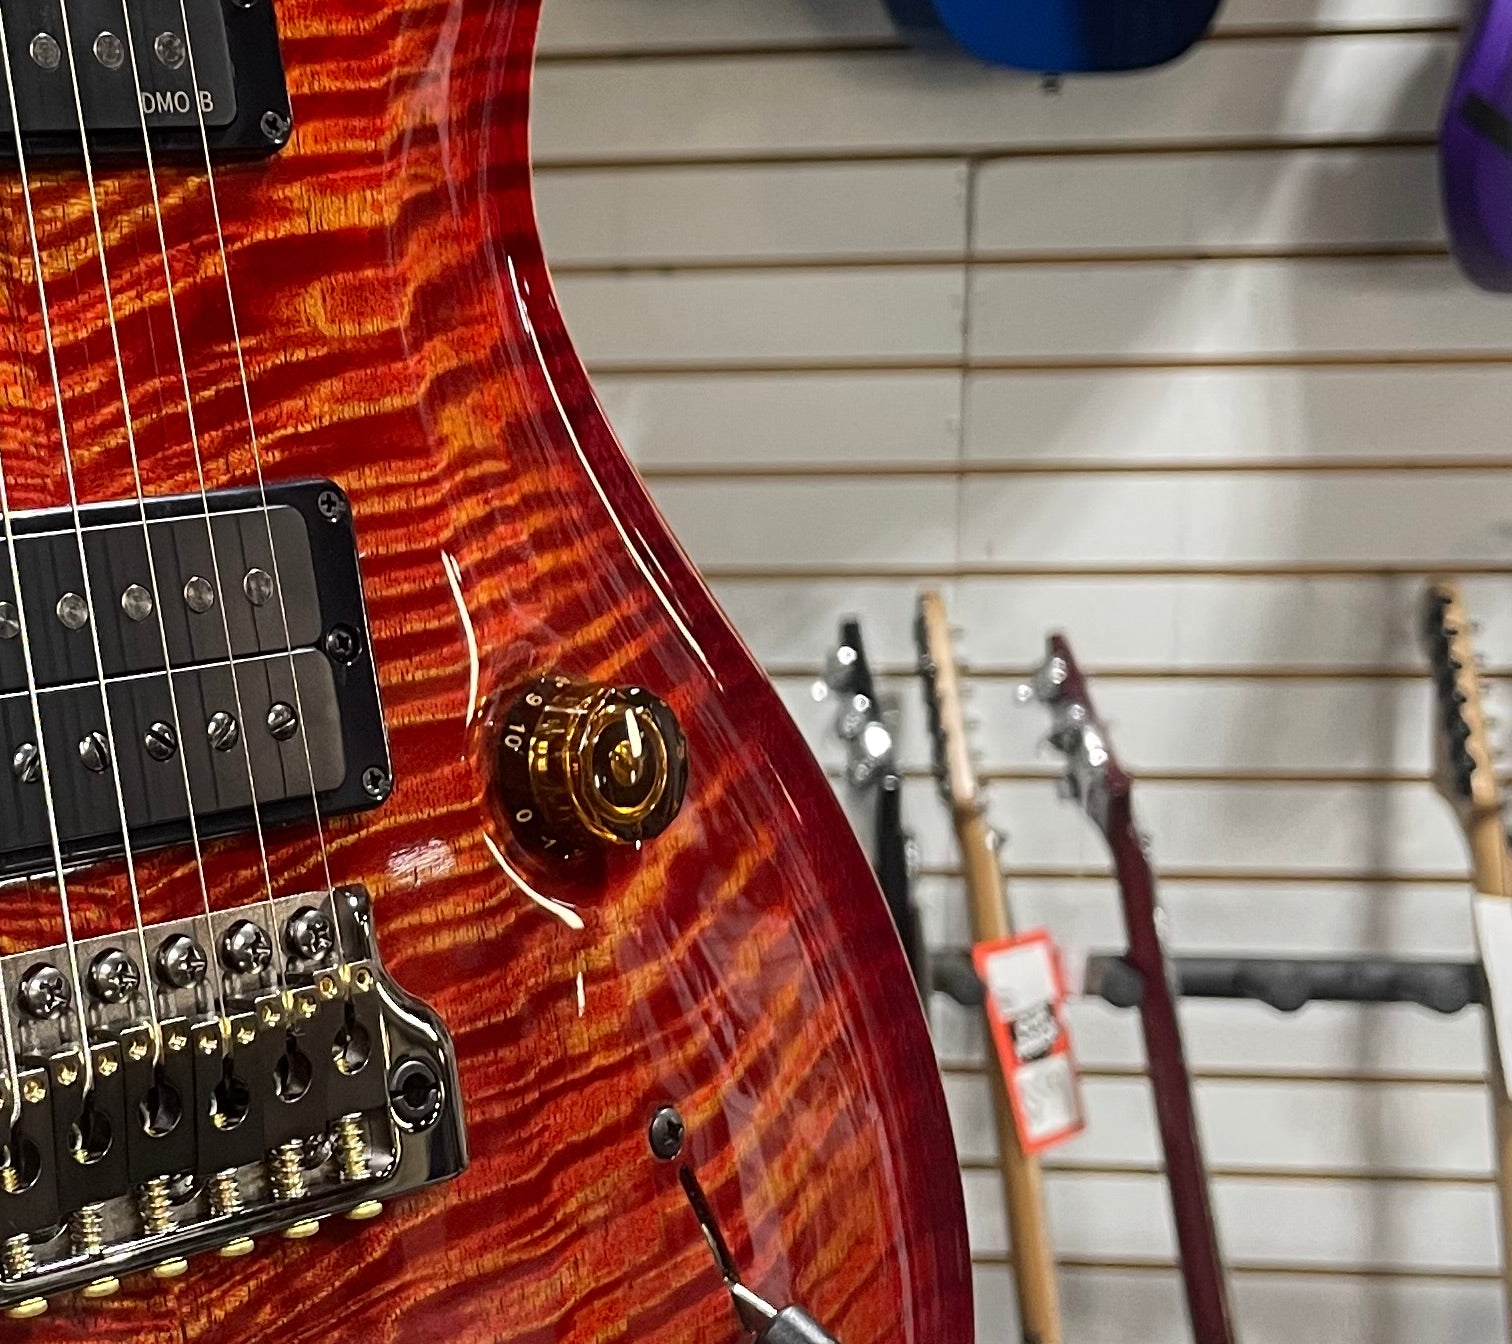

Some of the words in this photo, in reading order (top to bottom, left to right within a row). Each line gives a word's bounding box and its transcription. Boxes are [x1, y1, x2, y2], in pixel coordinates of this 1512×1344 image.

[141, 91, 190, 114] DMO
[199, 90, 214, 113] B
[504, 723, 526, 748] 10
